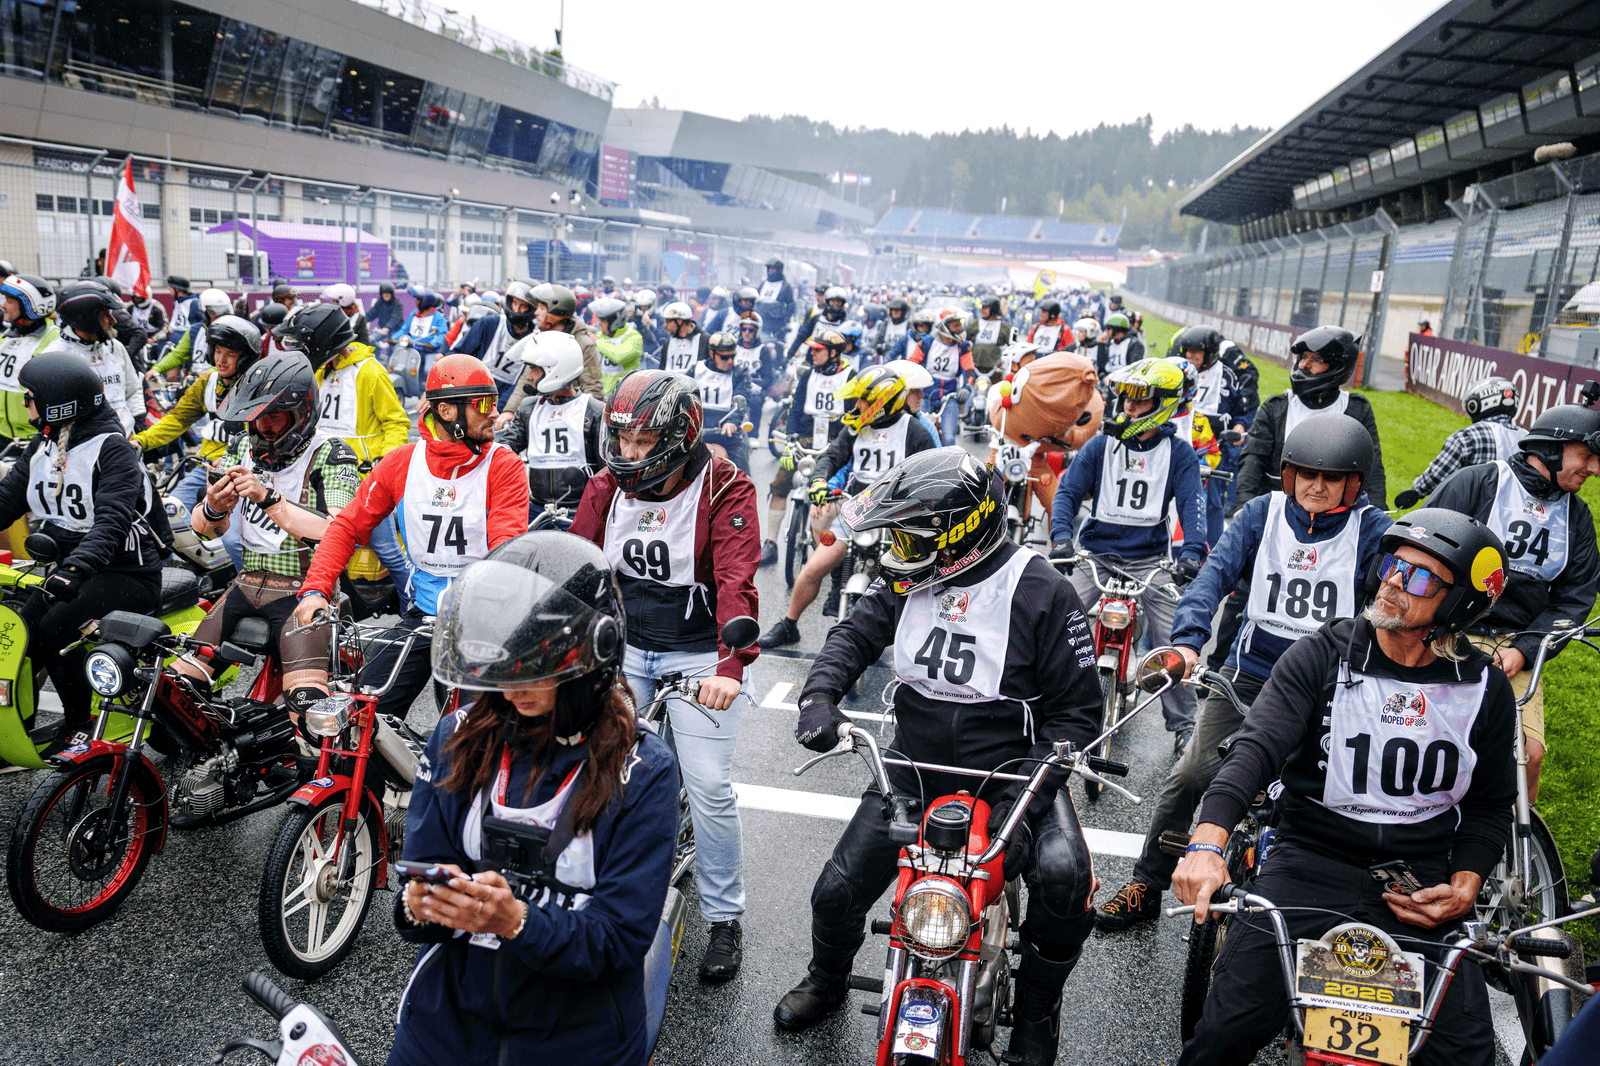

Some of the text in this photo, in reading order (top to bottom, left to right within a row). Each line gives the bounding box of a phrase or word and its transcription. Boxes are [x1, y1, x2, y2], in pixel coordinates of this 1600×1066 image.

[671, 354, 692, 369] 147
[934, 357, 950, 372] 32
[1410, 342, 1441, 390] QATAR
[101, 374, 121, 386] HRER
[322, 393, 341, 420] 21
[704, 386, 720, 404] 11
[815, 391, 834, 410] 68
[542, 428, 569, 454] 15
[859, 447, 895, 471] 211
[35, 481, 87, 520] 173
[1116, 478, 1149, 510] 19
[241, 497, 281, 535] MEDIA
[934, 495, 995, 549] 100%
[422, 514, 467, 555] 74
[1505, 520, 1550, 567] 34
[622, 538, 671, 582] 69
[940, 549, 981, 576] Red Bull
[1266, 572, 1338, 622] 189
[914, 626, 976, 685] 45
[1345, 733, 1460, 797] 100
[1351, 805, 1381, 814] MopedGP
[1356, 929, 1375, 938] JAHRE
[1336, 944, 1347, 952] 10
[1371, 949, 1387, 957] JAHRE
[1325, 981, 1394, 1002] 2026
[1310, 996, 1410, 1016] WWW.PIRATEZ-PMC.COM
[1341, 1009, 1372, 1022] 2025
[1327, 1015, 1382, 1058] 32
